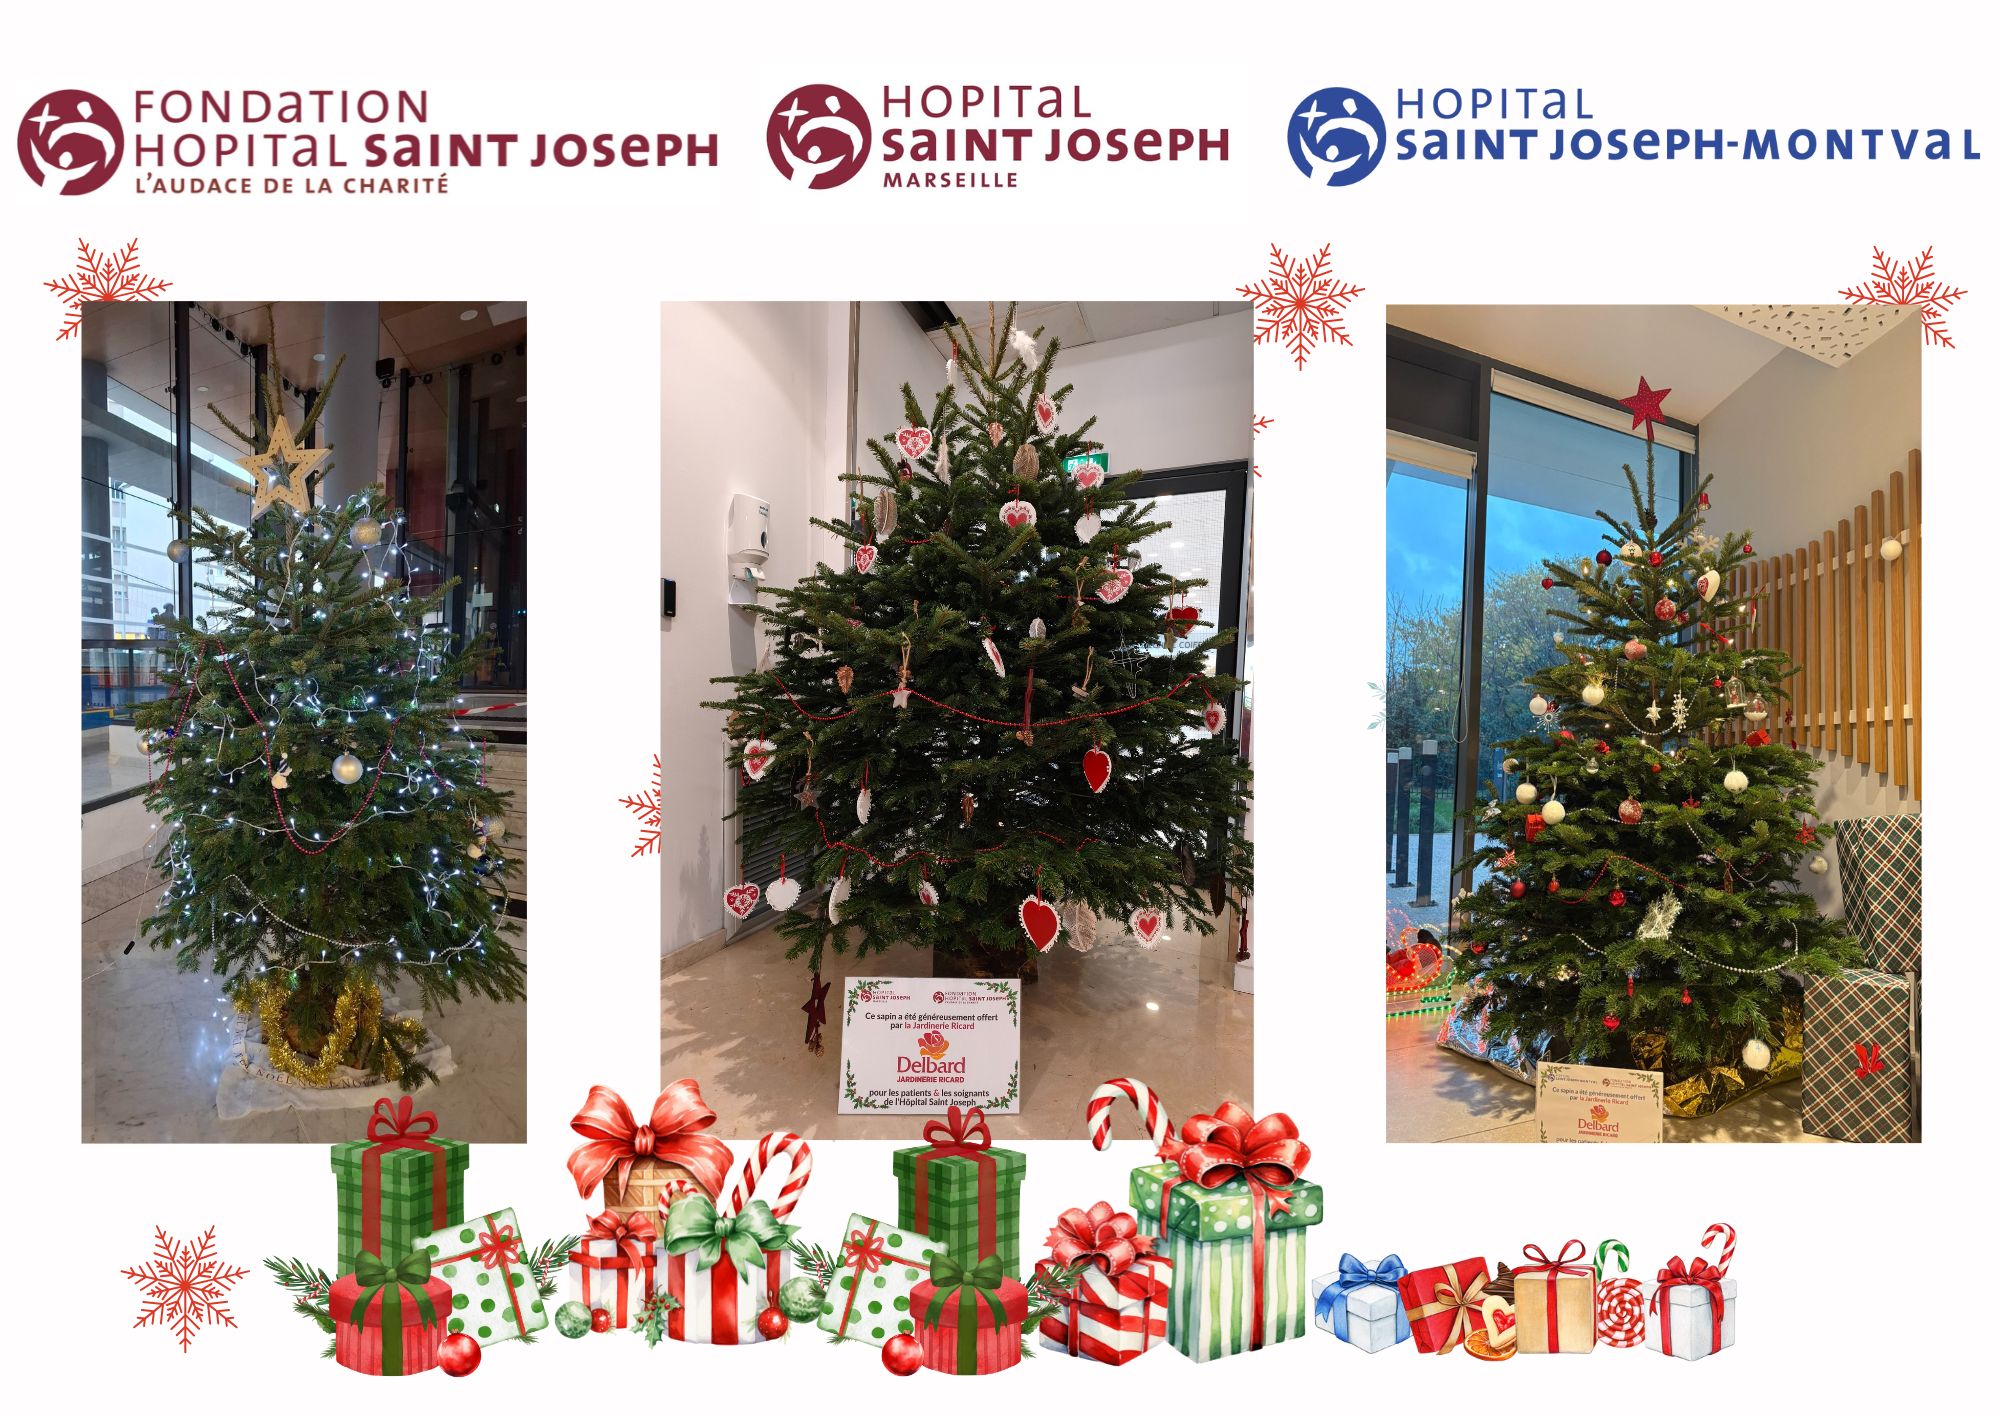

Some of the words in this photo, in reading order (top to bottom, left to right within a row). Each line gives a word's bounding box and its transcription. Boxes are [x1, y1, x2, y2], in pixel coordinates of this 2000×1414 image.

[865, 1012, 875, 1020] Ce
[877, 1013, 896, 1021] sapin
[918, 1013, 975, 1022] généreusement
[977, 1013, 998, 1021] offert
[912, 1022, 949, 1030] Jardinerie
[951, 1022, 975, 1030] Ricard
[897, 1056, 966, 1073] Delbard
[900, 1089, 931, 1097] patients
[933, 1089, 939, 1097] &
[941, 1089, 952, 1097] les
[953, 1089, 990, 1098] soignants
[884, 1098, 893, 1106] de
[929, 1098, 948, 1106] Saint
[950, 1098, 976, 1107] Joseph
[1578, 1119, 1619, 1132] Delbard
